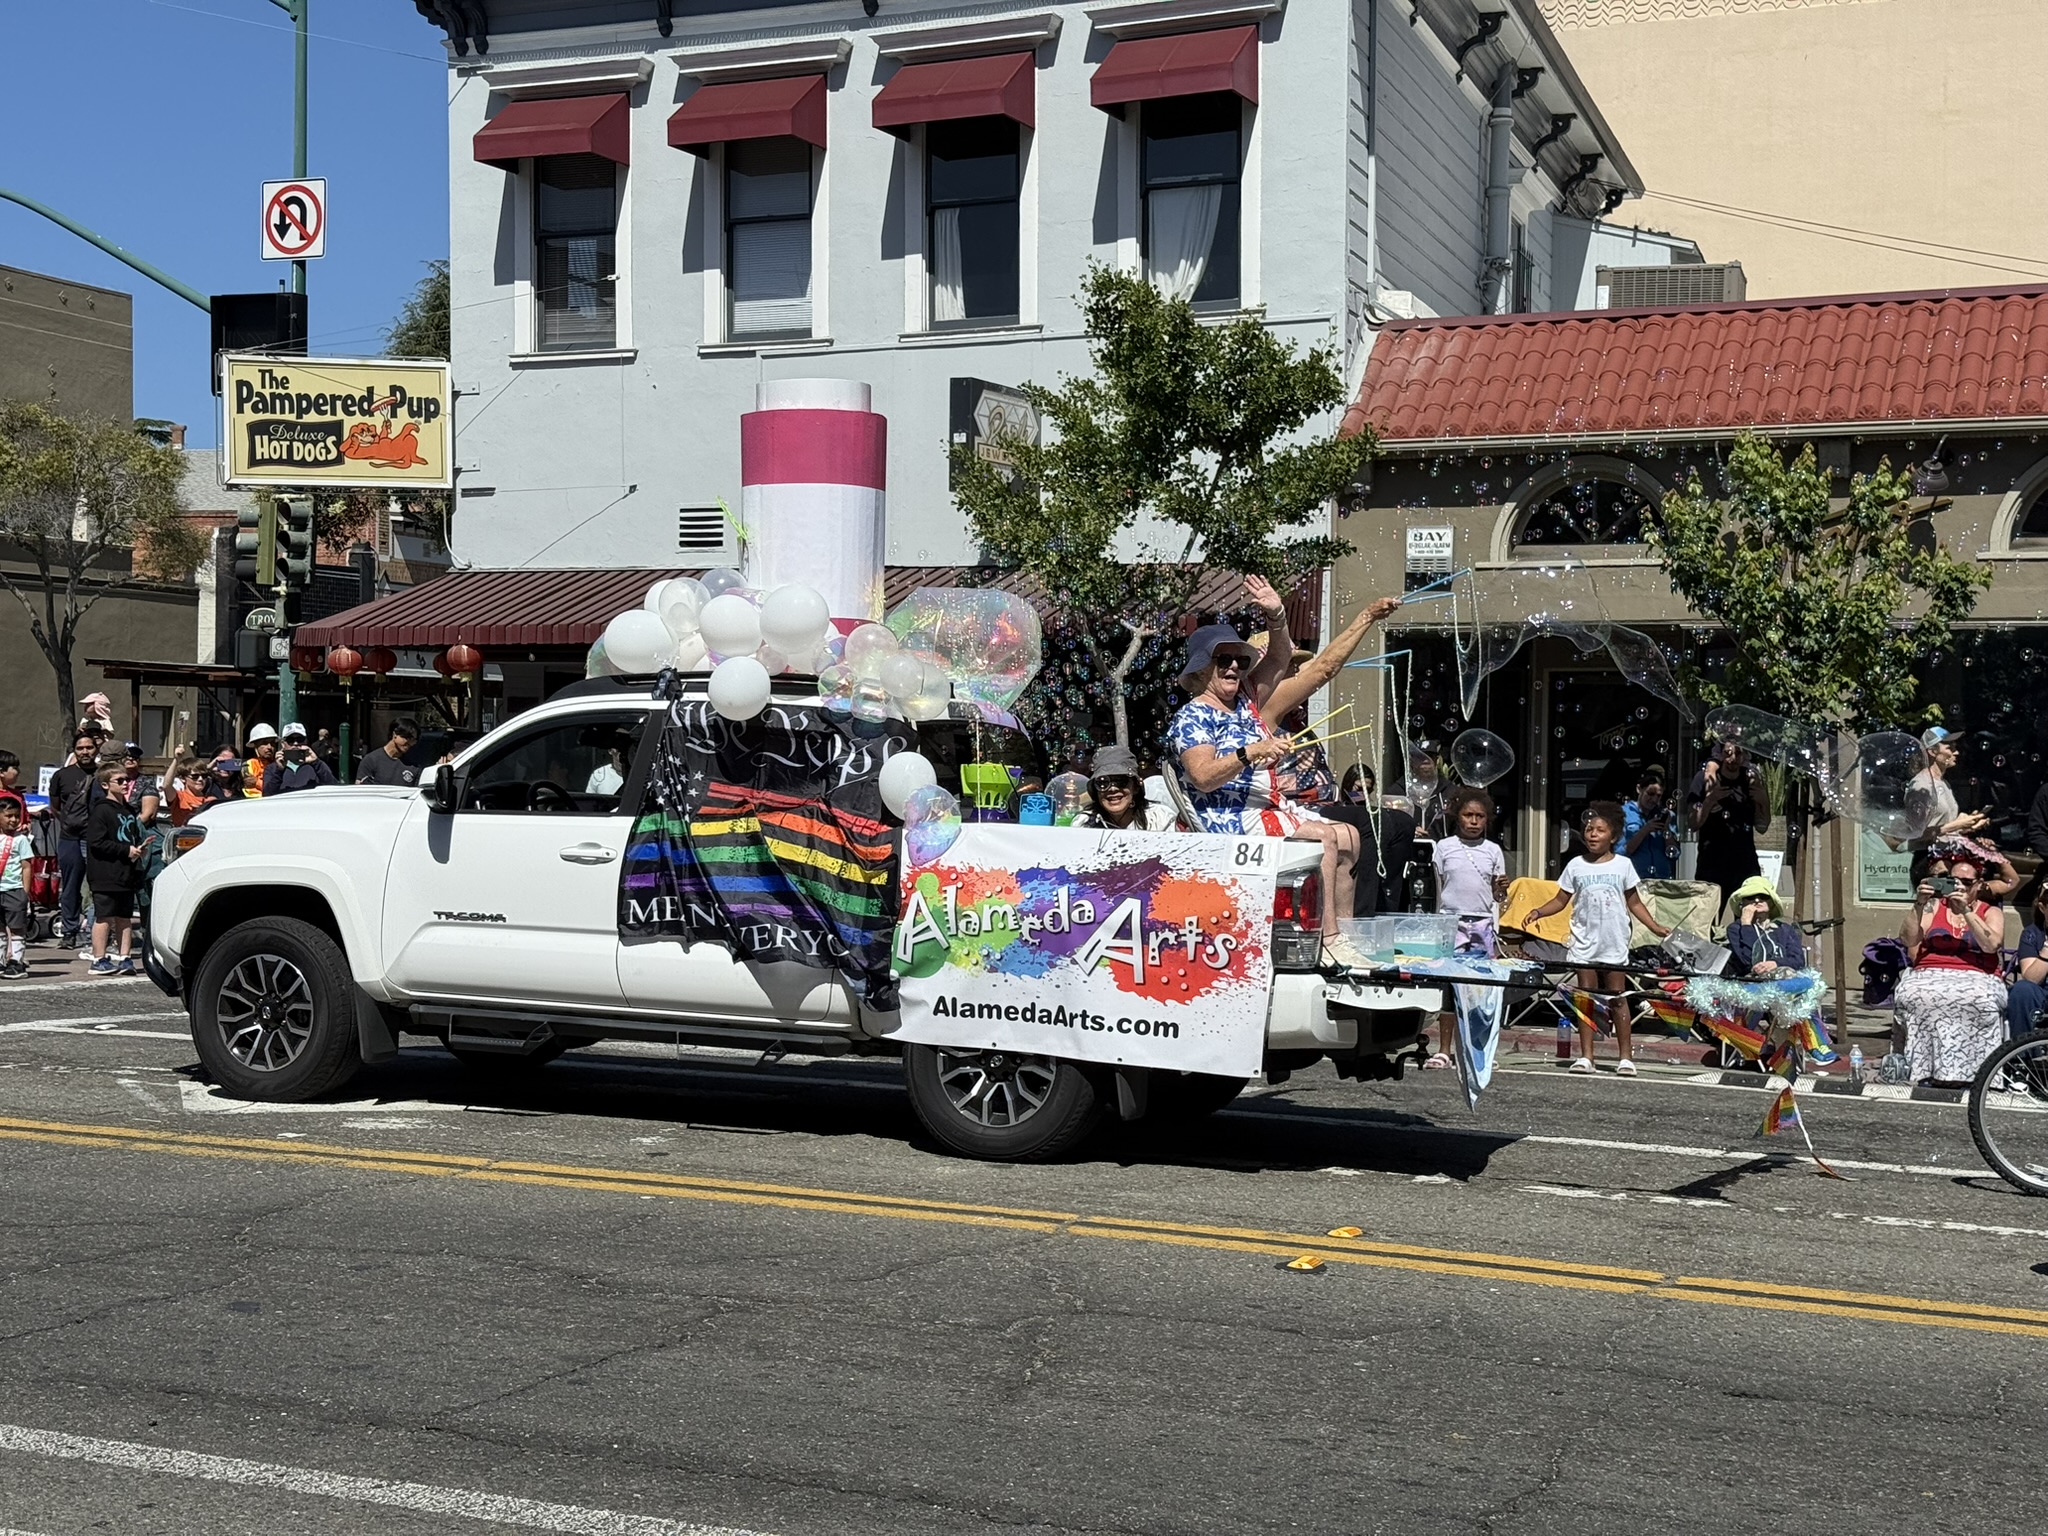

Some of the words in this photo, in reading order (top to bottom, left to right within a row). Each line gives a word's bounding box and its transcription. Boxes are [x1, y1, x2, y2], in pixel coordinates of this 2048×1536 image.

[258, 369, 290, 390] The
[236, 378, 375, 420] Pampered
[389, 384, 441, 423] Pup
[269, 423, 328, 440] Deluxe
[255, 435, 291, 461] HOT
[293, 436, 339, 463] DOGS
[1413, 532, 1447, 541] BAY
[1234, 842, 1265, 866] 84
[433, 911, 507, 923] TACOMA
[896, 885, 1096, 964] Alameda
[1073, 897, 1238, 984] Arts
[932, 995, 1180, 1040] AlamedaArts.com
